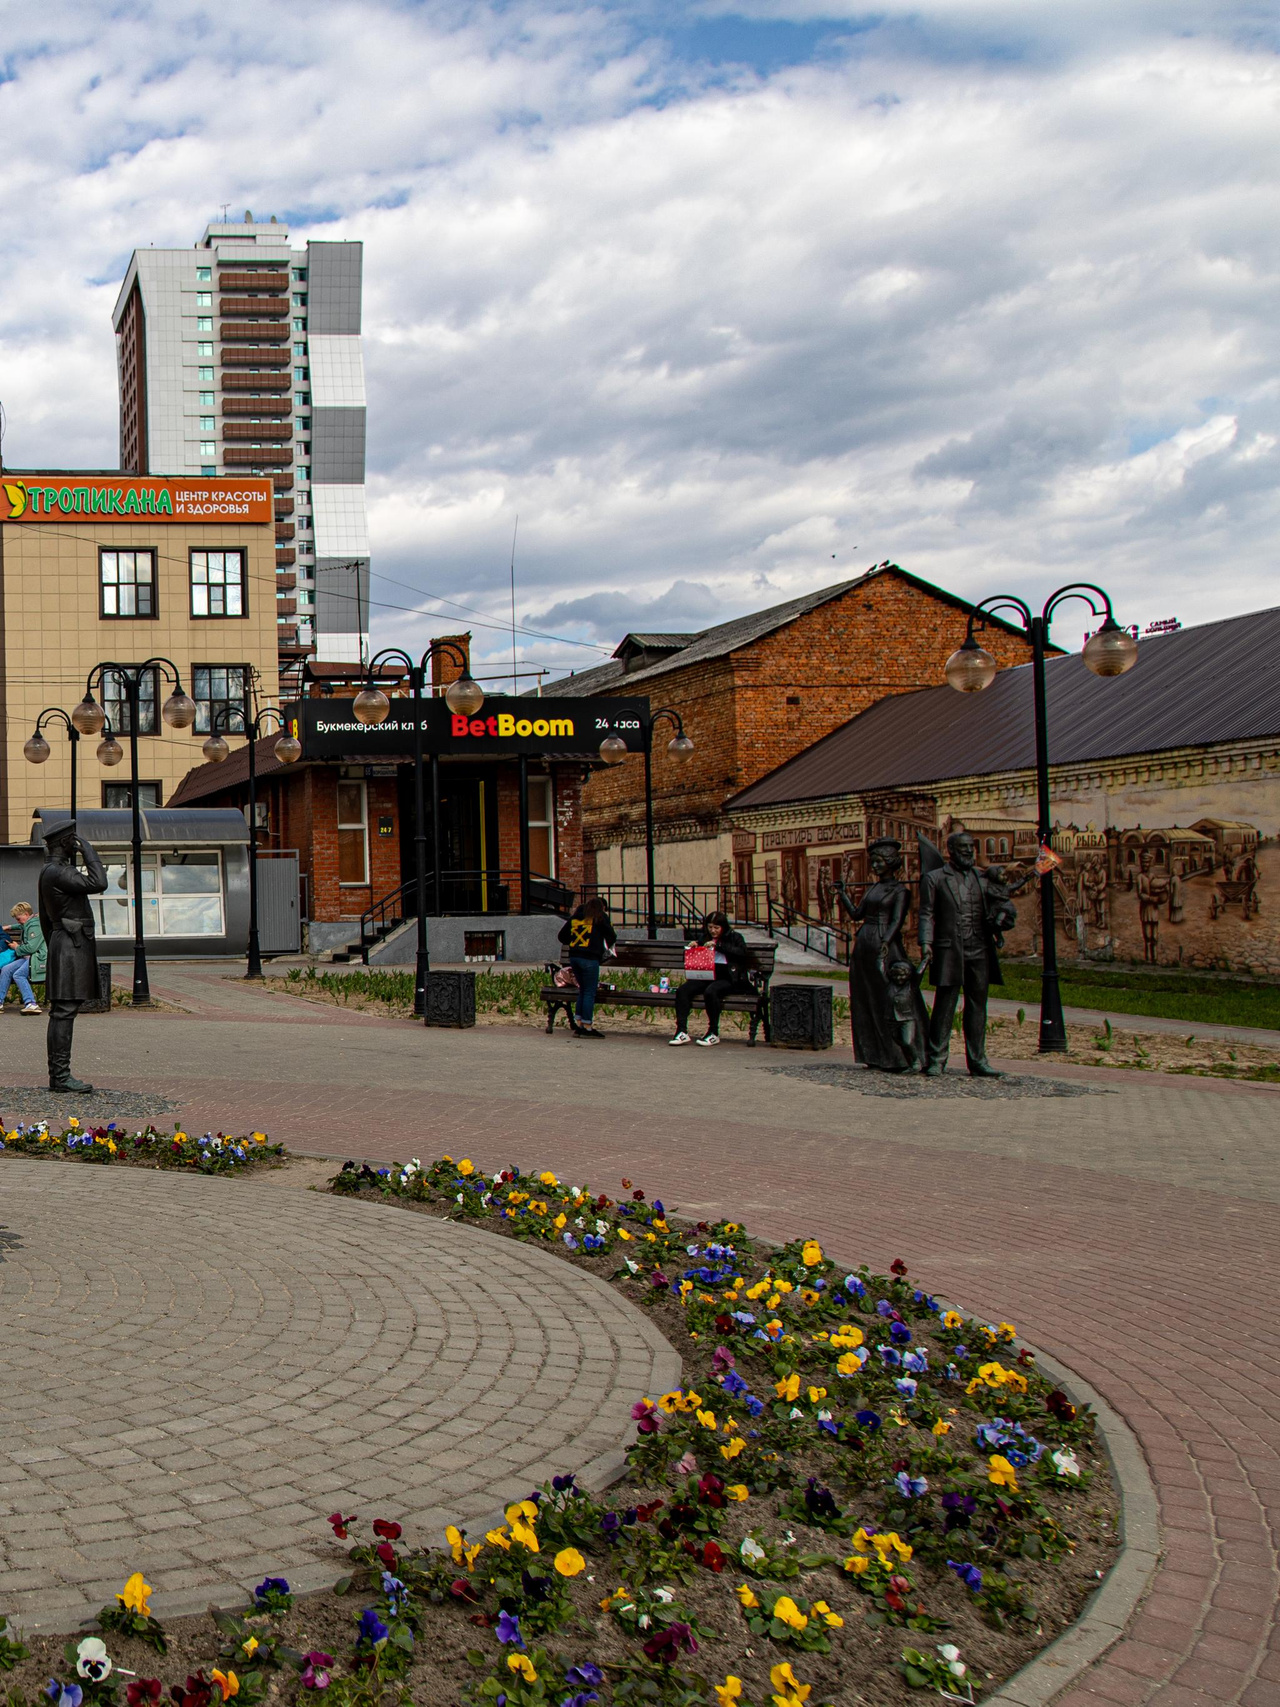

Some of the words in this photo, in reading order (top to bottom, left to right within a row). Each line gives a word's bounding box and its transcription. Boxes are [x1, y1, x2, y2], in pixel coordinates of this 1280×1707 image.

[27, 487, 173, 514] ТРОПИКАНА
[176, 491, 210, 503] ЦЕНТР
[211, 490, 267, 503] КРАСОТЫ
[176, 503, 185, 514] И
[186, 503, 249, 515] ЗДОРОВЬЯ
[316, 720, 399, 733] Букмекерский
[401, 720, 428, 731] клб
[451, 714, 574, 738] BetBoom
[595, 718, 610, 729] 24
[1076, 833, 1106, 848] РЫБА
